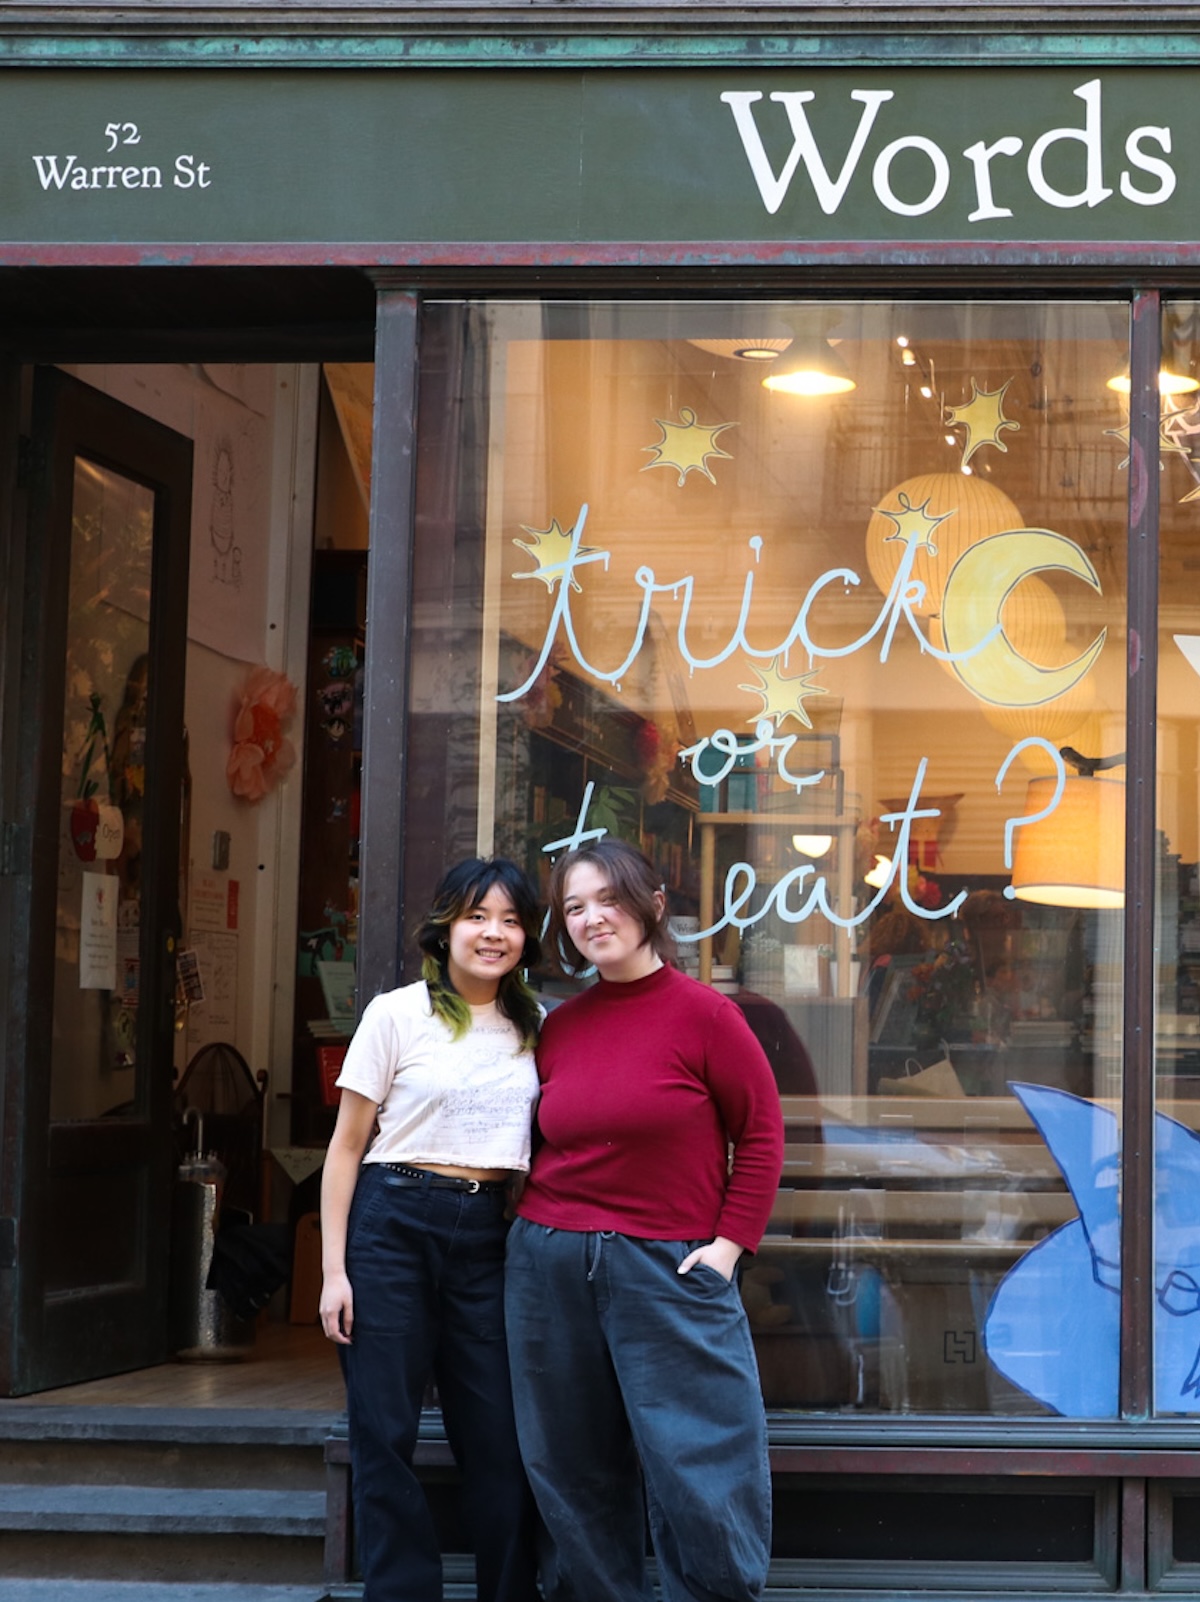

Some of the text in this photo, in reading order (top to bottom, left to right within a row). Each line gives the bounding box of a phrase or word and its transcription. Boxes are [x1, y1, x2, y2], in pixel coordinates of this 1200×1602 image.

[32, 154, 212, 191] Warren St
[104, 122, 141, 154] 52
[719, 78, 1178, 223] Words
[494, 502, 1004, 704] trick
[678, 719, 826, 795] or
[539, 736, 1066, 979] teat?
